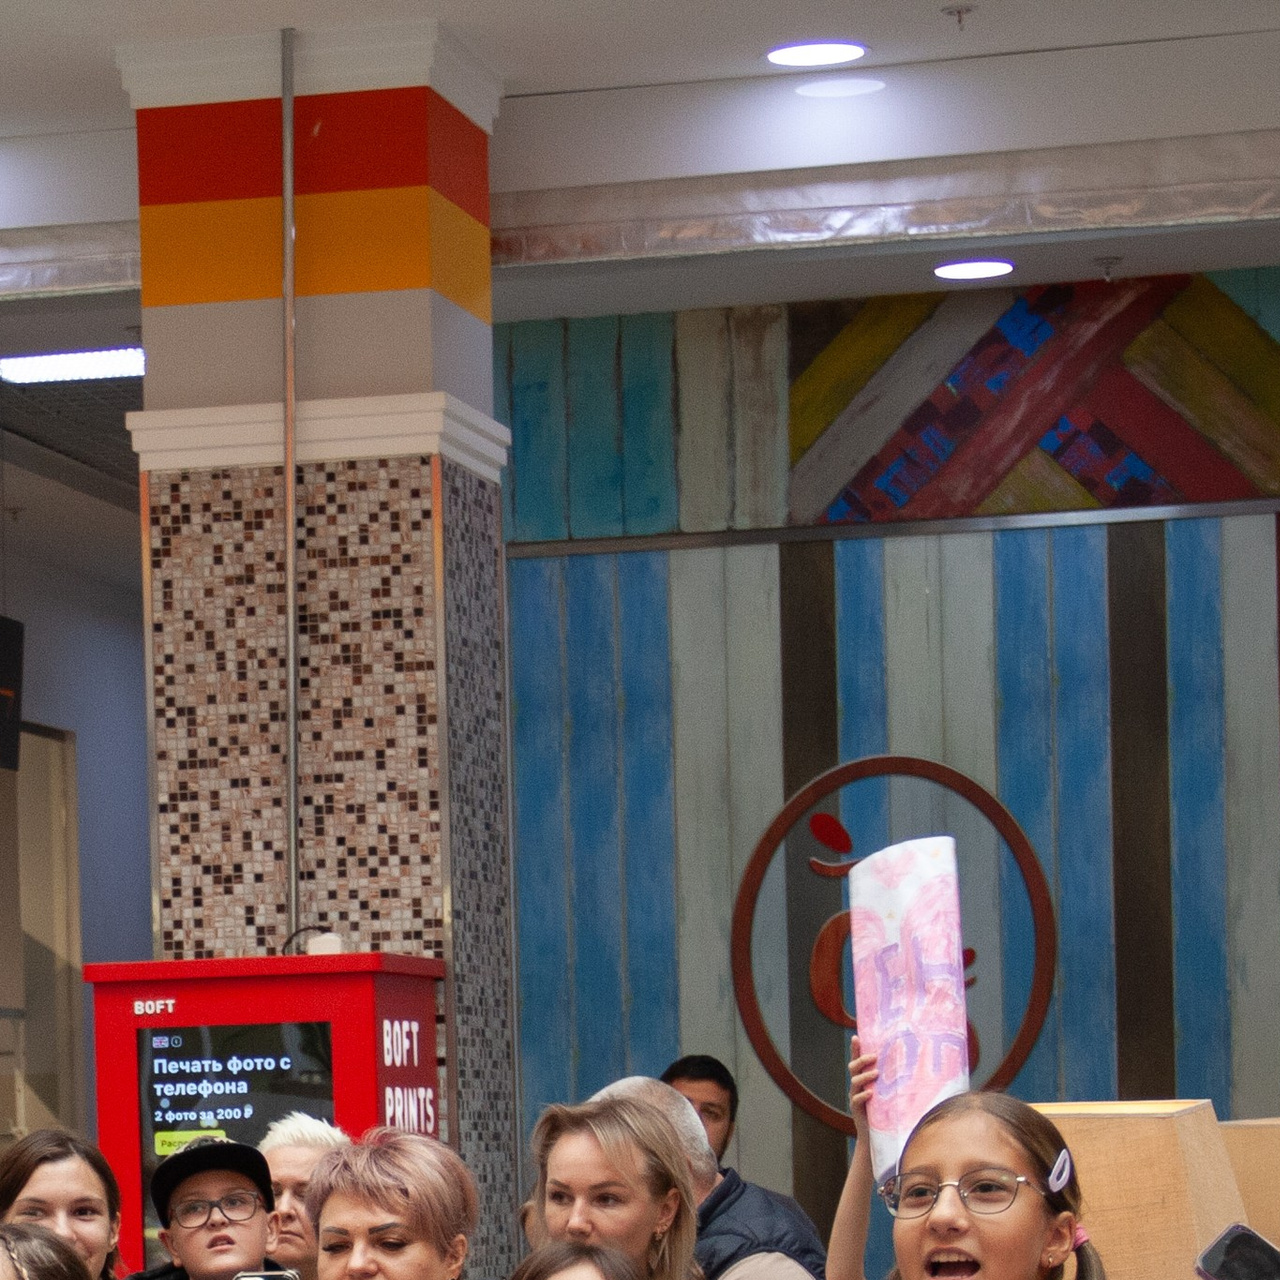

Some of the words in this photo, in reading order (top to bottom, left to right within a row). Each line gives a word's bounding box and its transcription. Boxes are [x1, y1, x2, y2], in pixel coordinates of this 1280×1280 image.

[133, 999, 176, 1016] BOFT
[382, 1019, 420, 1068] BOFT
[153, 1058, 224, 1075] Печать
[227, 1056, 276, 1075] фото
[279, 1057, 292, 1070] с
[153, 1079, 249, 1098] телефона
[154, 1110, 163, 1121] 2
[165, 1110, 197, 1123] фото
[199, 1110, 215, 1121] за
[216, 1108, 242, 1120] 200
[384, 1086, 435, 1134] PRINTS
